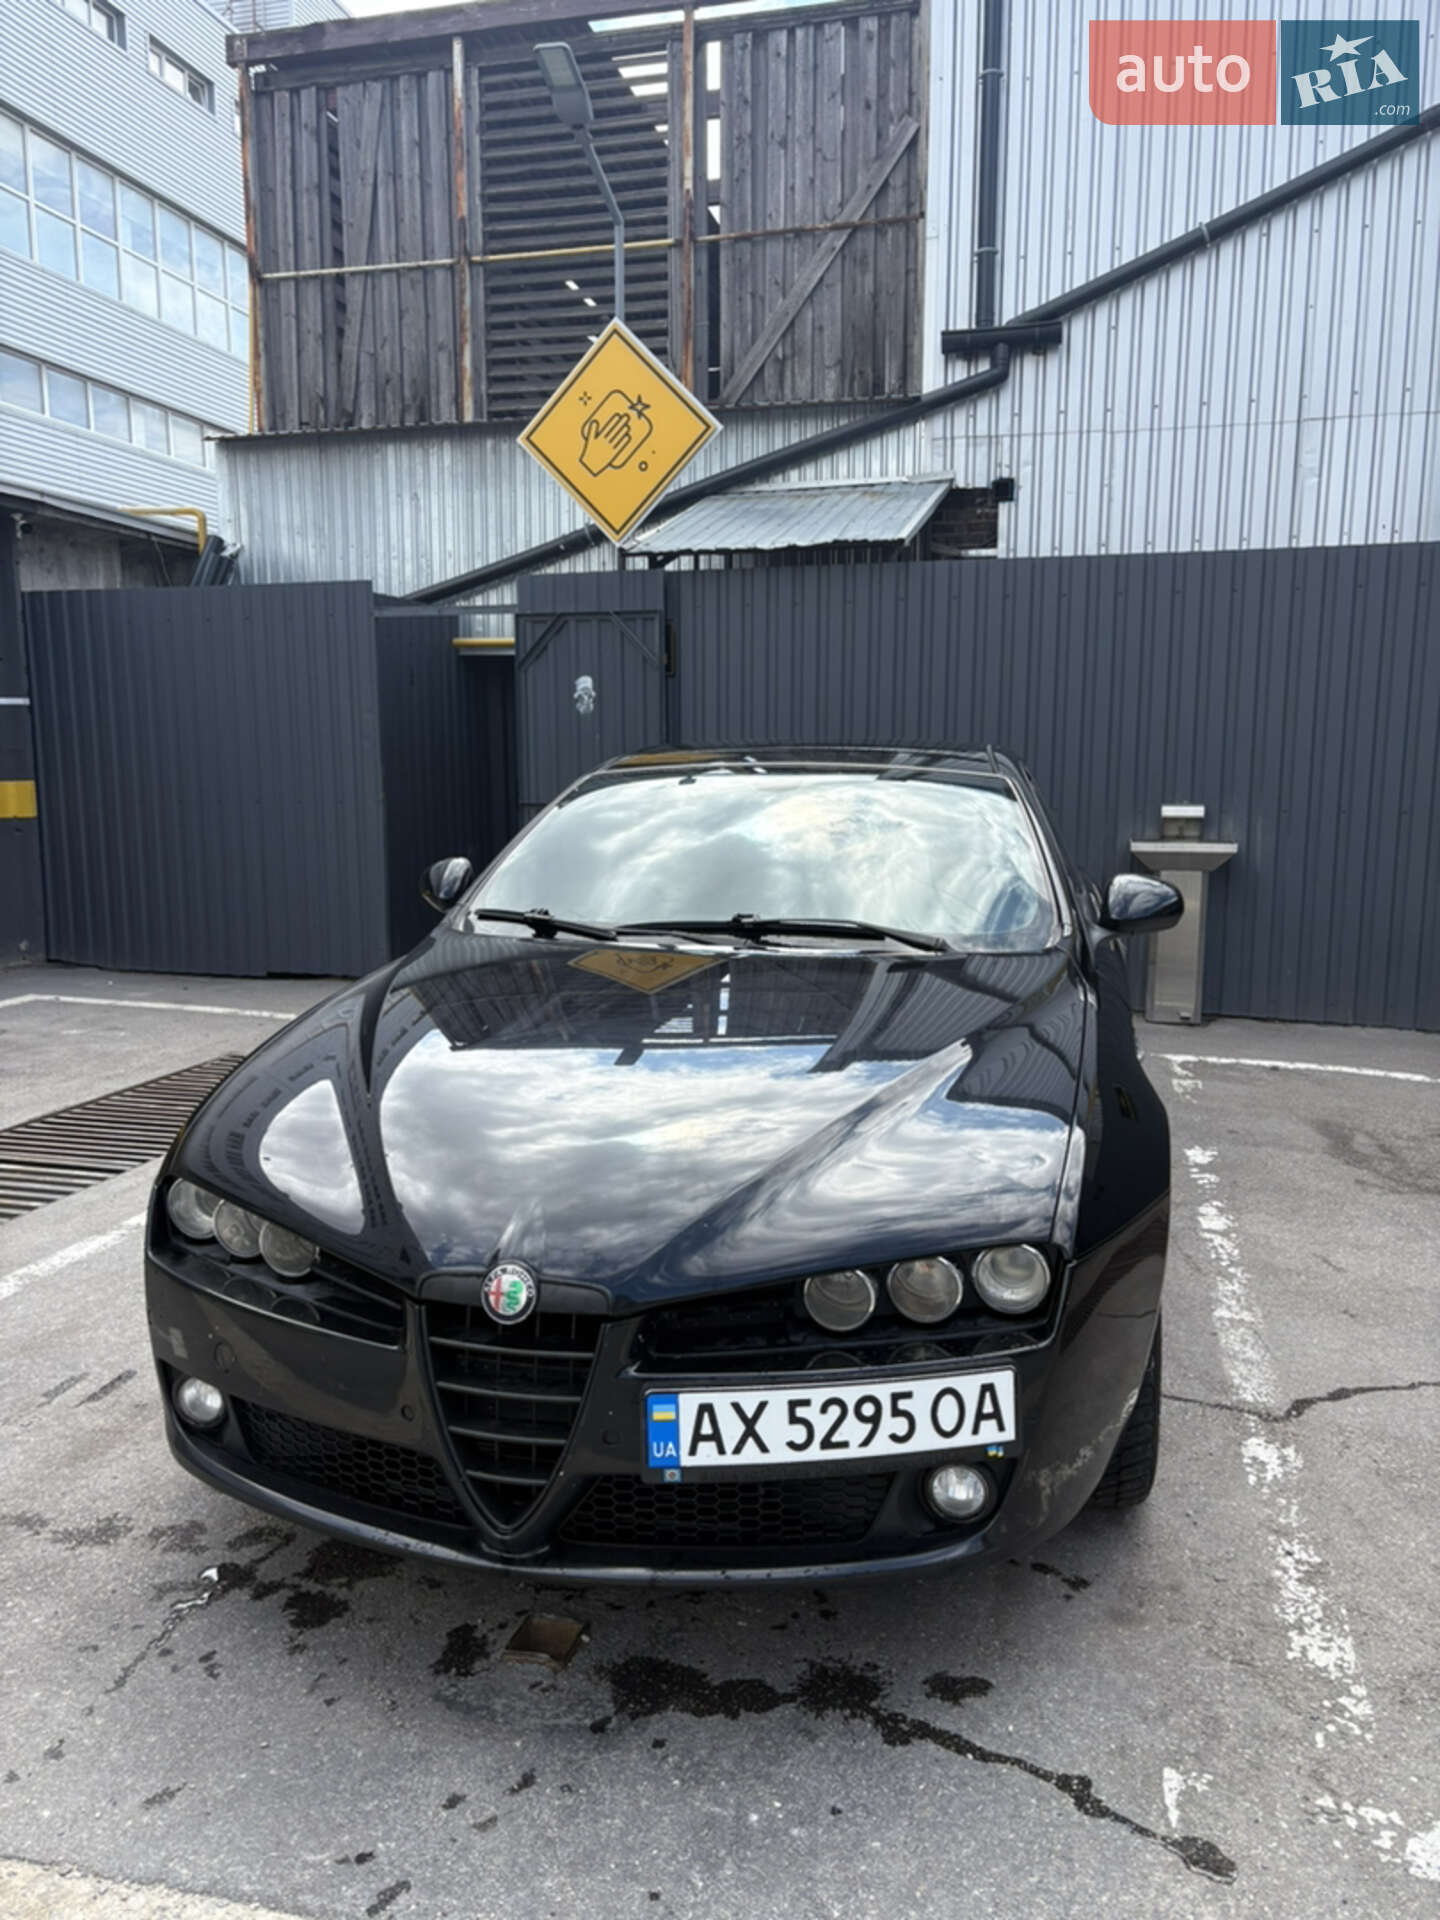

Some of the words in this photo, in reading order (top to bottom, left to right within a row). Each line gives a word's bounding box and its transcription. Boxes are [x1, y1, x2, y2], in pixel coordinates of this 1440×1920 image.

[687, 1400, 771, 1457] AX
[785, 1391, 917, 1452] 5295
[930, 1382, 1007, 1440] OA
[652, 1441, 677, 1458] UA
